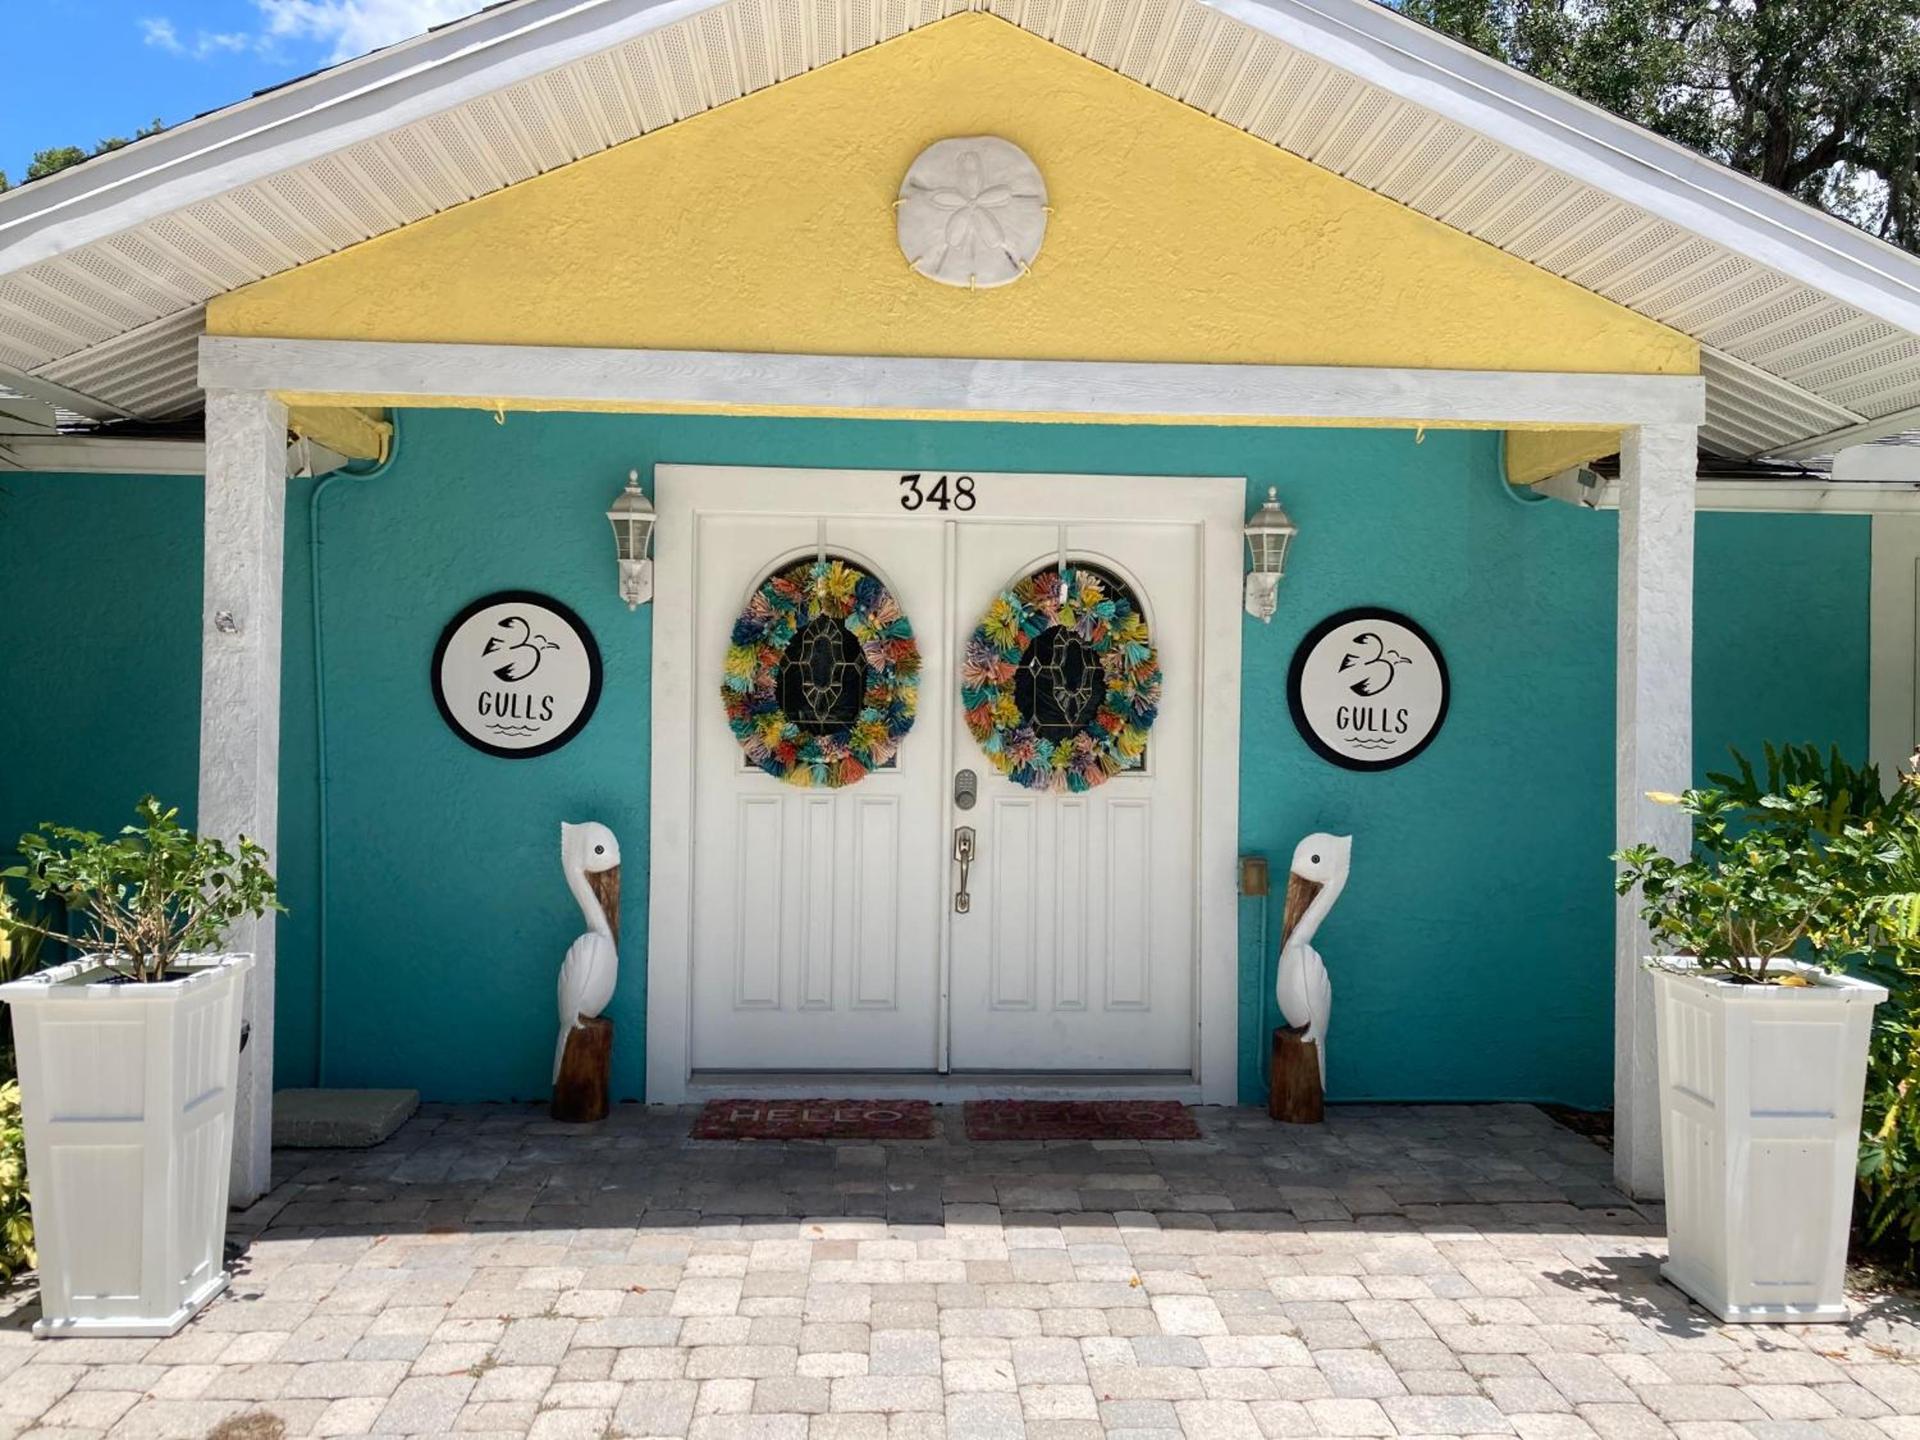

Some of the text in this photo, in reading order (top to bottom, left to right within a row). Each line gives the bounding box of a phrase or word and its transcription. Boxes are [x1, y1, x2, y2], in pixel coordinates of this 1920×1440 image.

[900, 474, 976, 511] 348
[478, 691, 554, 721] GULLS
[1336, 706, 1409, 734] GULLS
[730, 1108, 903, 1122] HELLO
